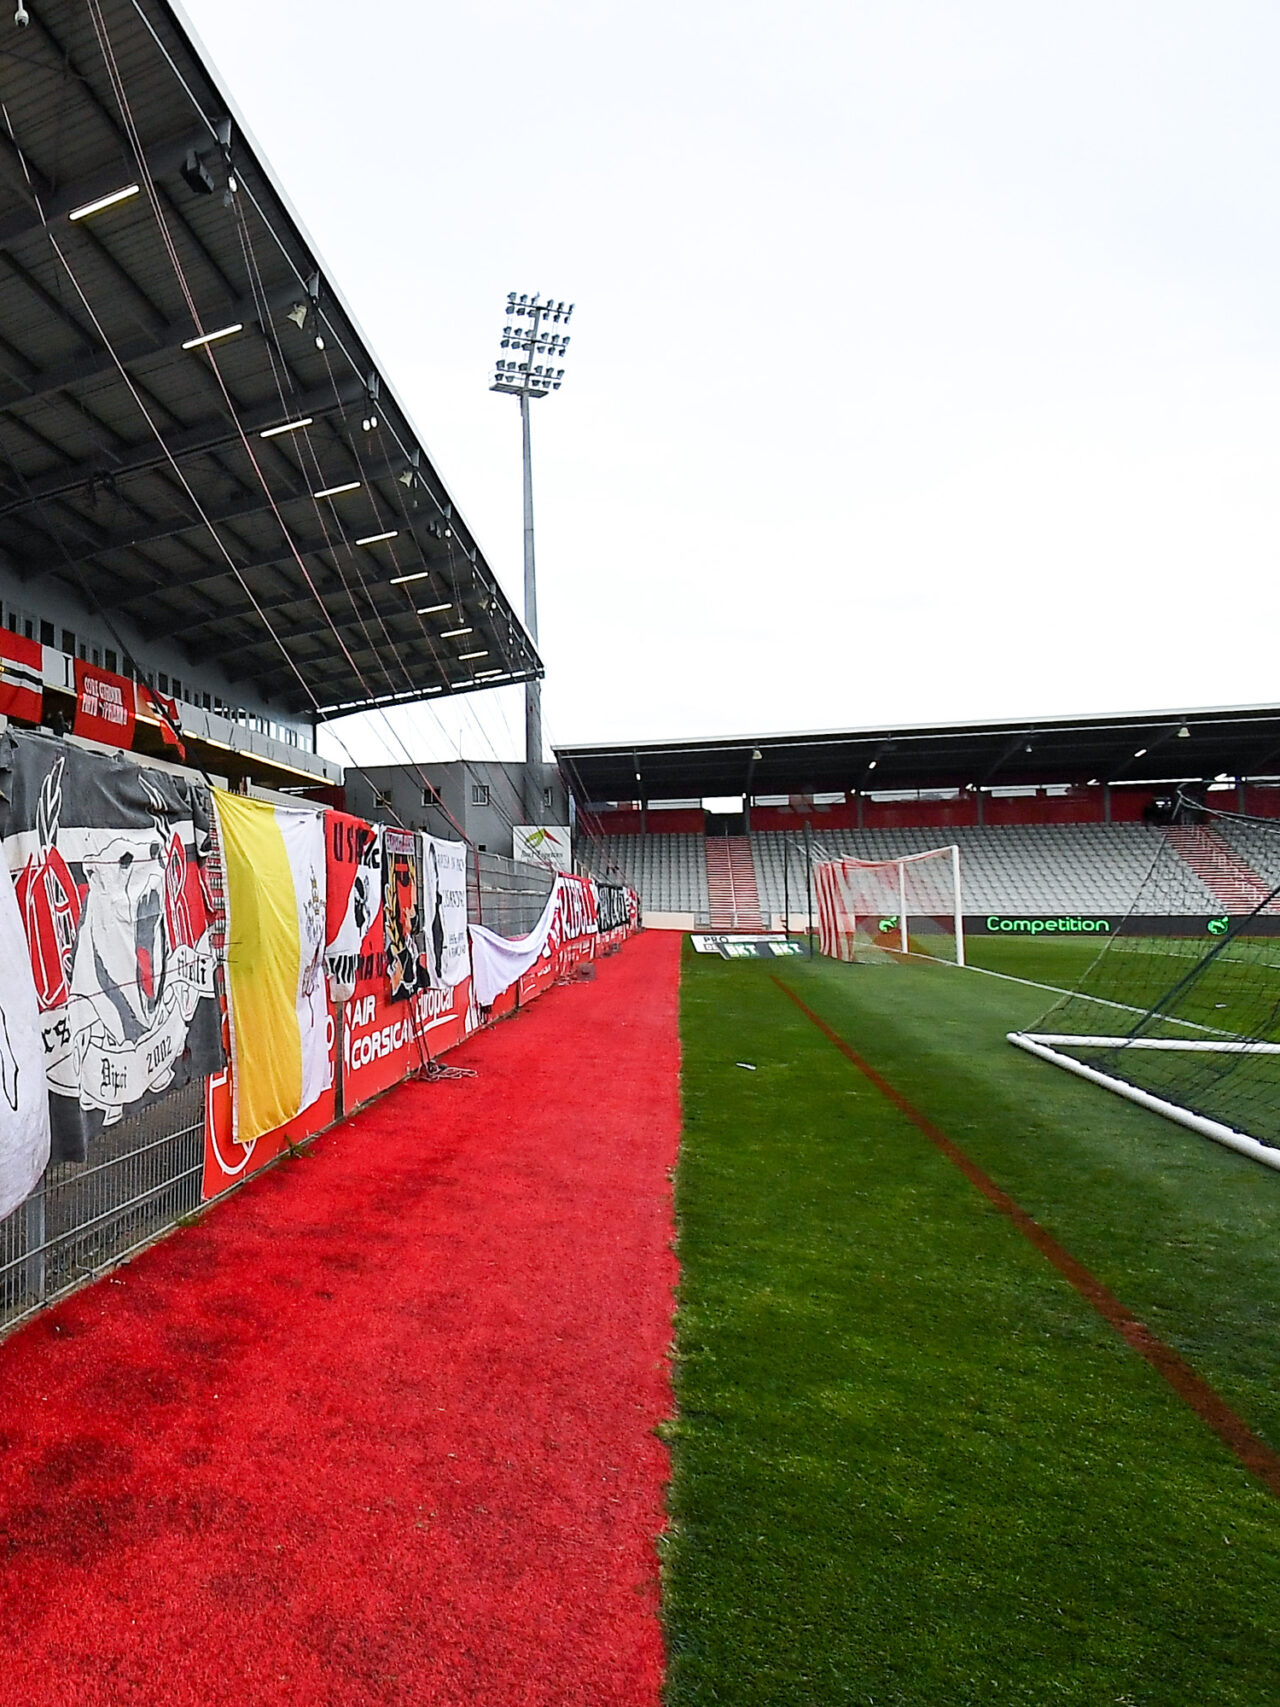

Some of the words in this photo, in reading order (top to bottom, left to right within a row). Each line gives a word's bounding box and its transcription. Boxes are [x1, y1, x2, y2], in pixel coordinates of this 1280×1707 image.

[986, 916, 1110, 935] Competition
[723, 942, 759, 958] BKT
[768, 942, 803, 957] BKT
[351, 994, 377, 1031] AIR
[146, 1035, 173, 1075] 2002
[351, 1018, 410, 1071] CORSICA
